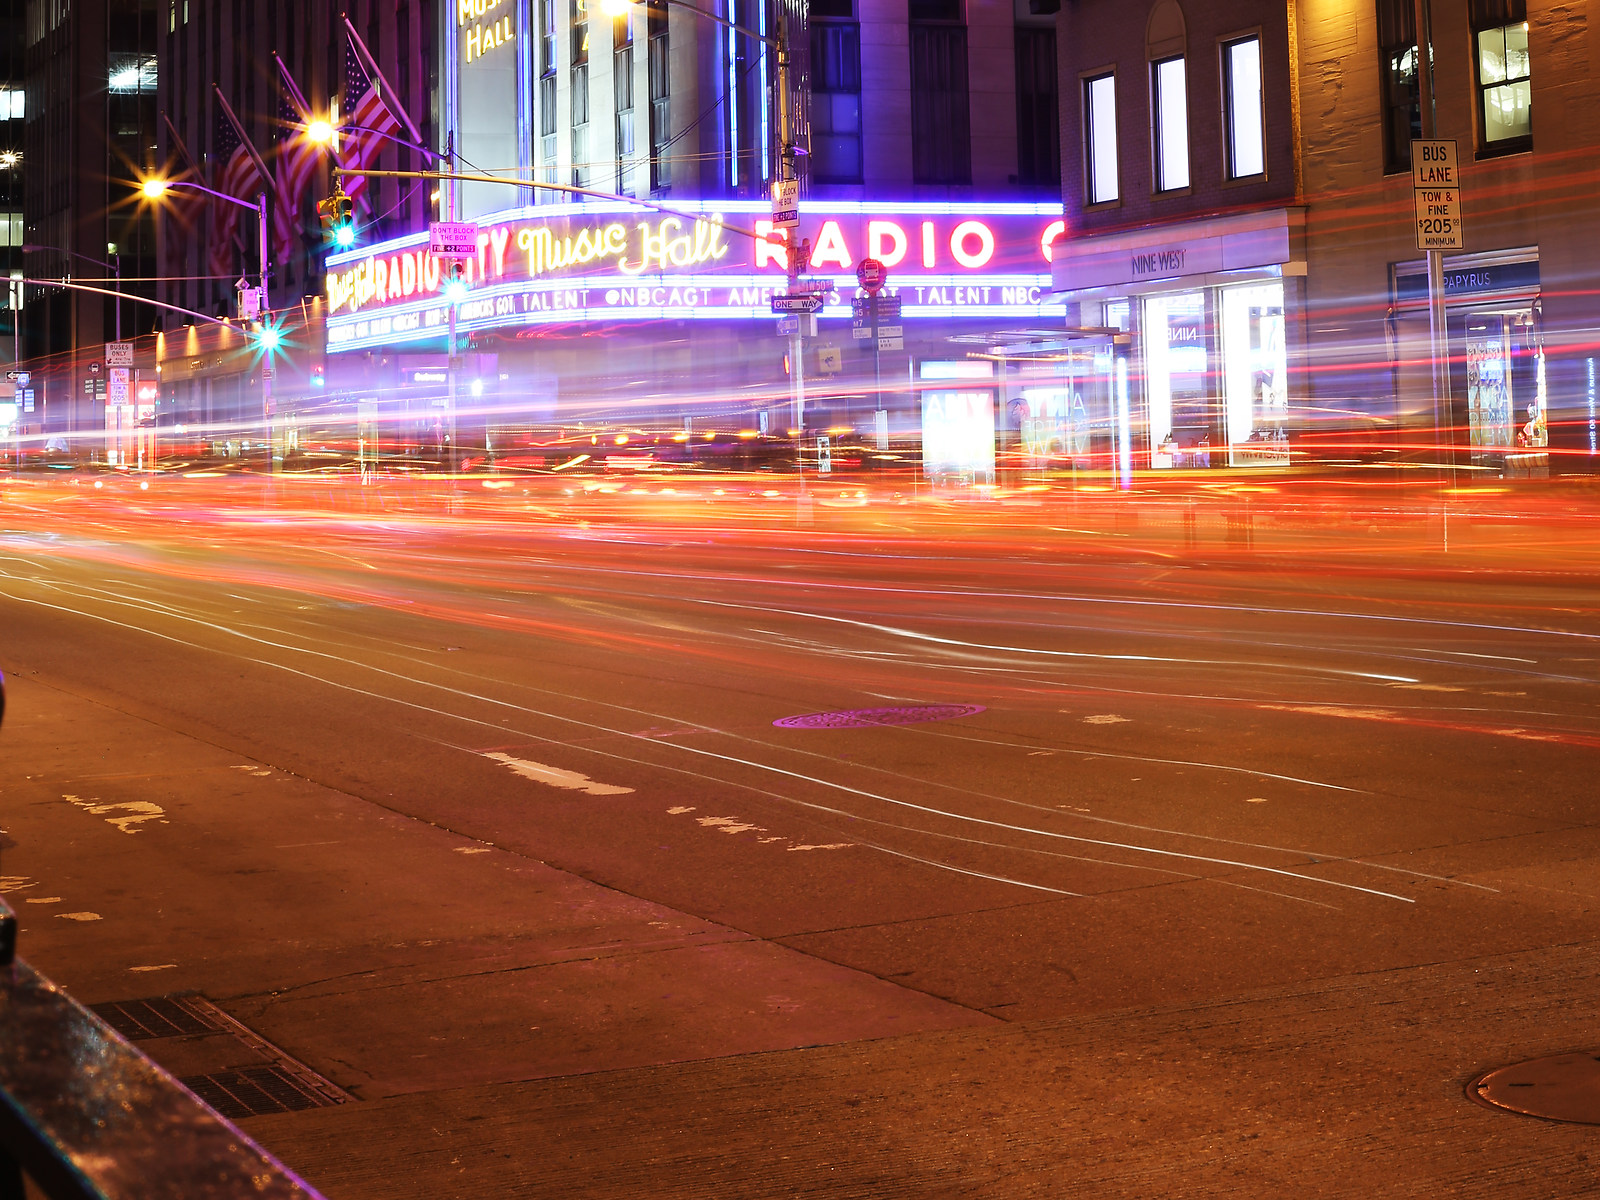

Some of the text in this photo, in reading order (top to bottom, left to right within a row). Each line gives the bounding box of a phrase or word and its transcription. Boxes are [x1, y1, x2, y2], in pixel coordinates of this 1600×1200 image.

[466, 16, 514, 63] HALL
[1422, 146, 1447, 161] BUS
[1420, 167, 1452, 182] LANE
[1421, 191, 1453, 202] TOW &
[1428, 204, 1449, 215] FINE
[755, 220, 995, 269] RADIO
[1425, 237, 1456, 246] MINIMUM
[1131, 249, 1187, 275] NINE WEST
[374, 249, 440, 303] RADIO
[1443, 272, 1491, 288] PAPYRUS
[816, 280, 826, 291] 50
[521, 289, 590, 311] TALENT
[914, 286, 992, 305] TALENT
[1001, 286, 1042, 305] NBC
[775, 300, 818, 308] ONE WAY
